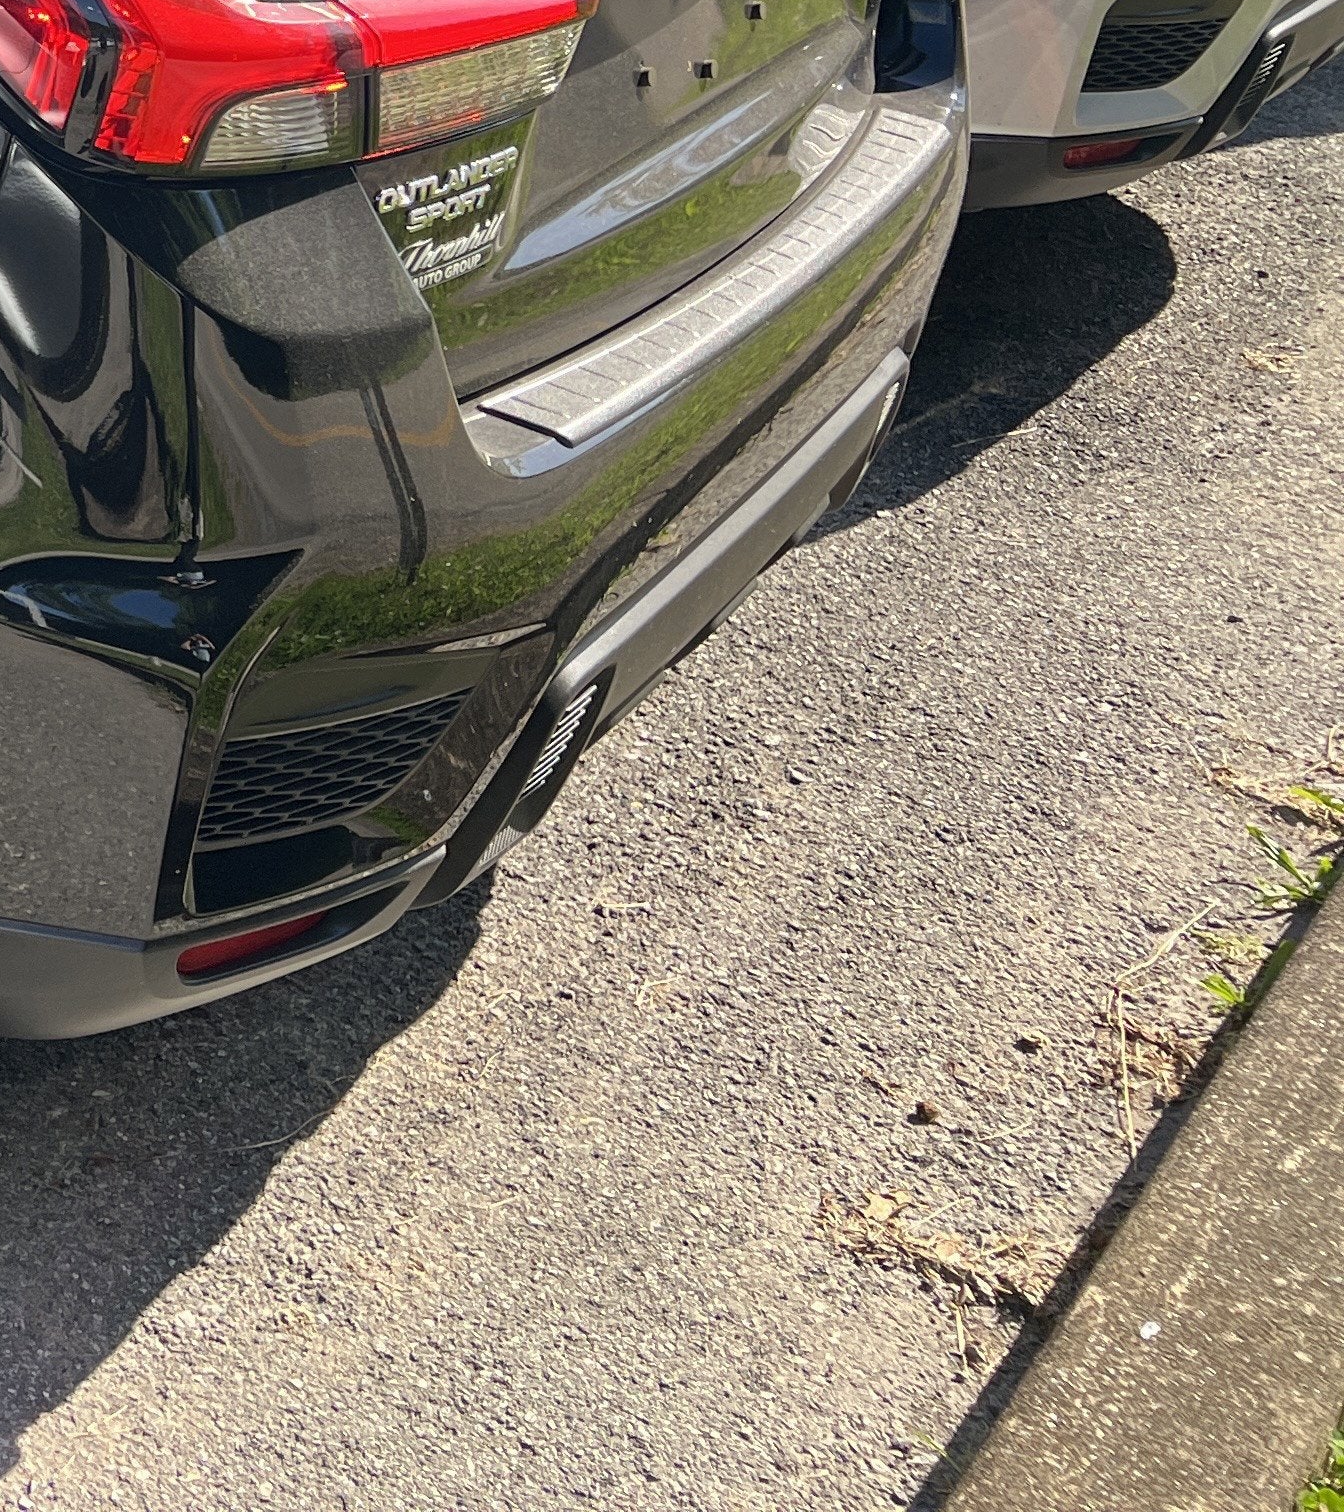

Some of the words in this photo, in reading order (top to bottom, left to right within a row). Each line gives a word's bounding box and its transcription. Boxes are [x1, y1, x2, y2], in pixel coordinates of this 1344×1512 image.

[375, 145, 520, 215] OUTLANDER
[405, 183, 492, 234] SPORT
[398, 210, 507, 273] Thornhill
[412, 269, 444, 289] AUTO
[444, 253, 482, 279] GROUP
